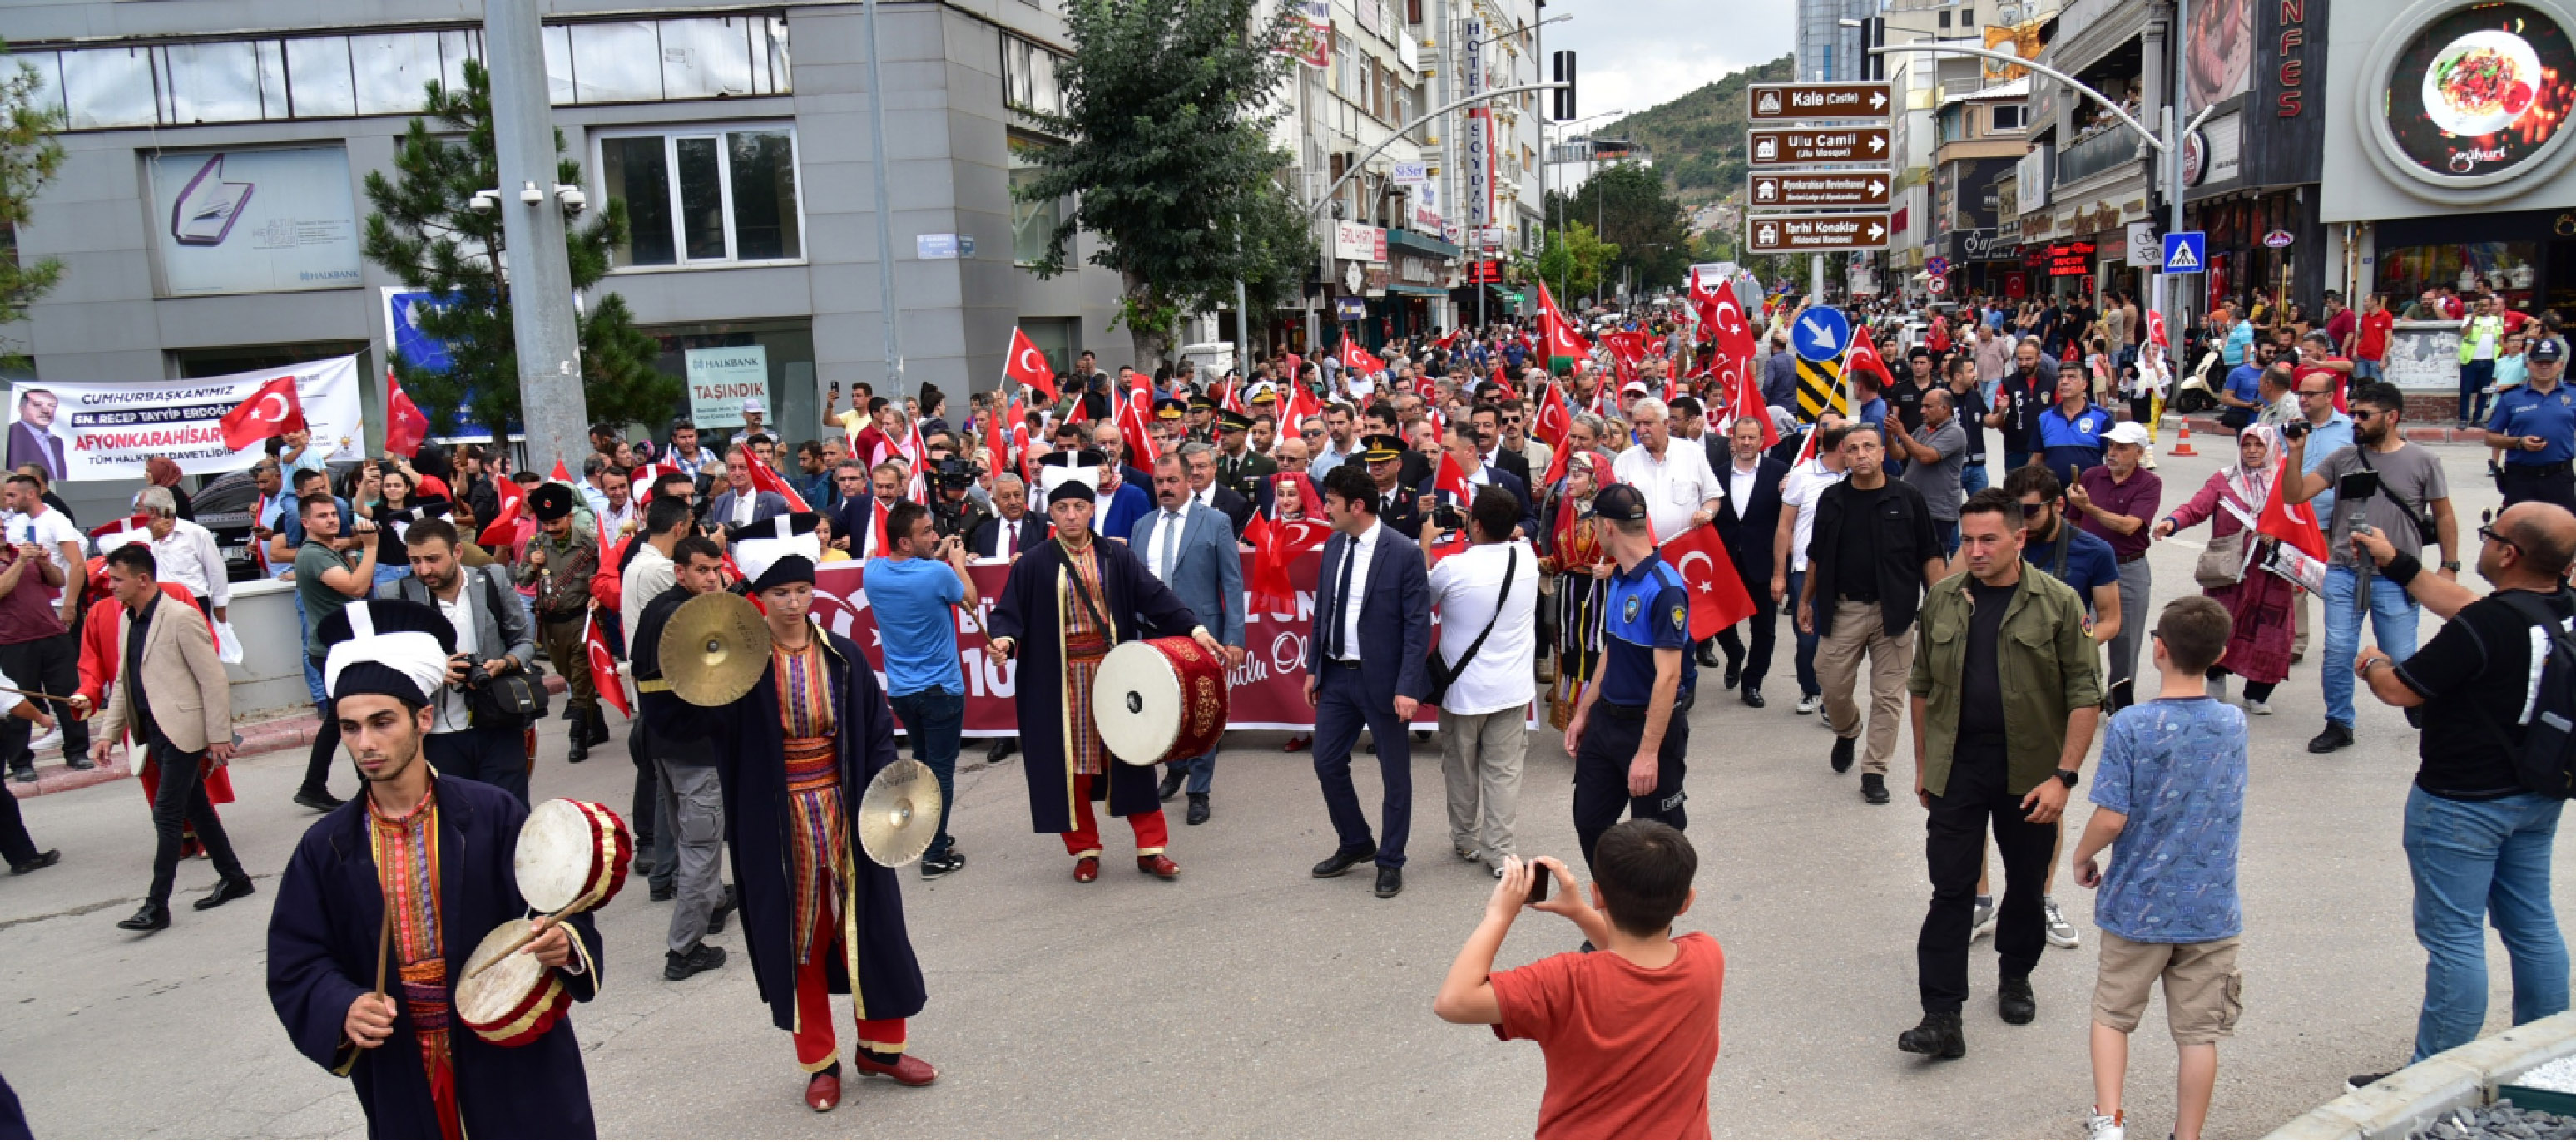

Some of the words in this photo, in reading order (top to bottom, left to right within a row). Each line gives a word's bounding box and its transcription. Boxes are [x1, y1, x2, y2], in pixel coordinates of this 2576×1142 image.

[1792, 91, 1825, 106] Kale
[1827, 92, 1860, 105] (Castle)
[1788, 135, 1812, 147] Ulu
[1816, 133, 1856, 146] Camii
[1796, 148, 1813, 160] (Ulu
[1815, 147, 1850, 158] Mosque)
[1785, 221, 1812, 234] Tarihi
[1815, 221, 1860, 233] Konaklar
[705, 358, 759, 369] HALKBANK
[82, 386, 235, 406] CUMHURBAŞKANIMIZ
[693, 382, 765, 401] TAŞINDIK
[73, 414, 96, 425] SN.
[98, 411, 137, 424] RECEP
[141, 408, 180, 422] TAYYİP
[74, 425, 220, 452] AFYONKARAHİSAR
[88, 453, 113, 465] TÜM
[958, 596, 997, 634] BÜ
[1271, 630, 1308, 675] Ol
